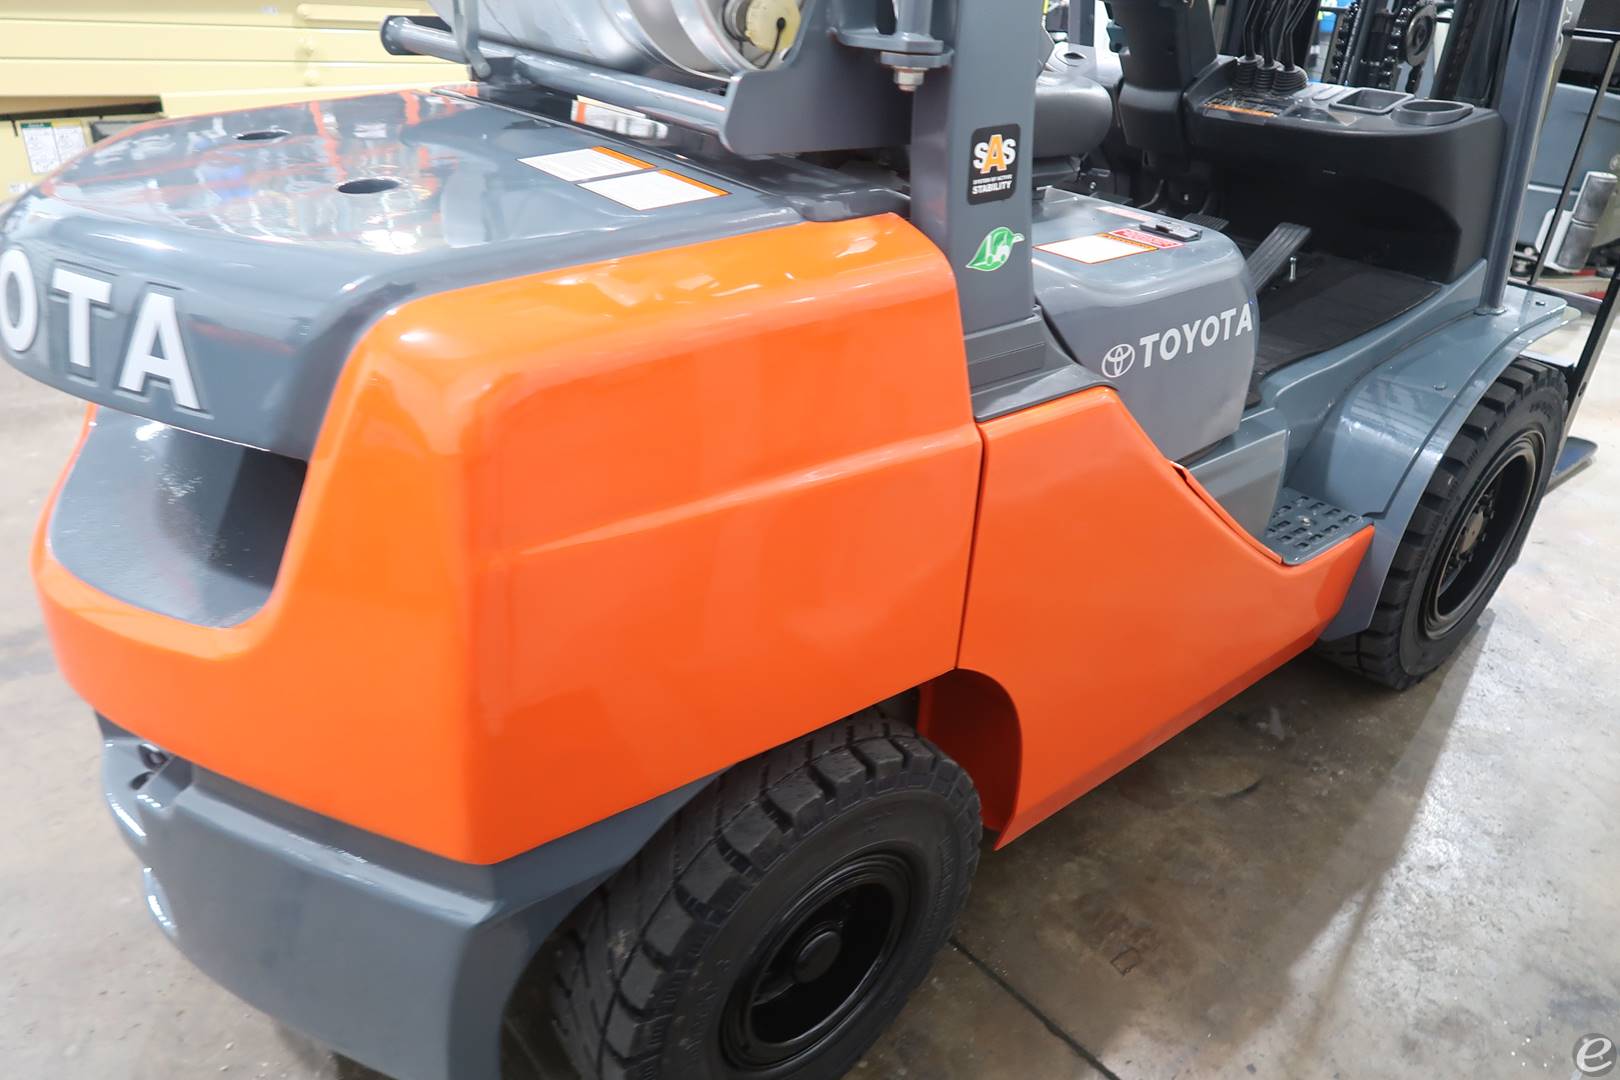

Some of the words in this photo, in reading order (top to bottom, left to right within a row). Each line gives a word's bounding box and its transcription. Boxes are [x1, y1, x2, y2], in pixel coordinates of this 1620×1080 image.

[973, 134, 1017, 174] SAS
[972, 181, 1012, 194] STABILITY
[1139, 303, 1253, 368] TOYOTA
